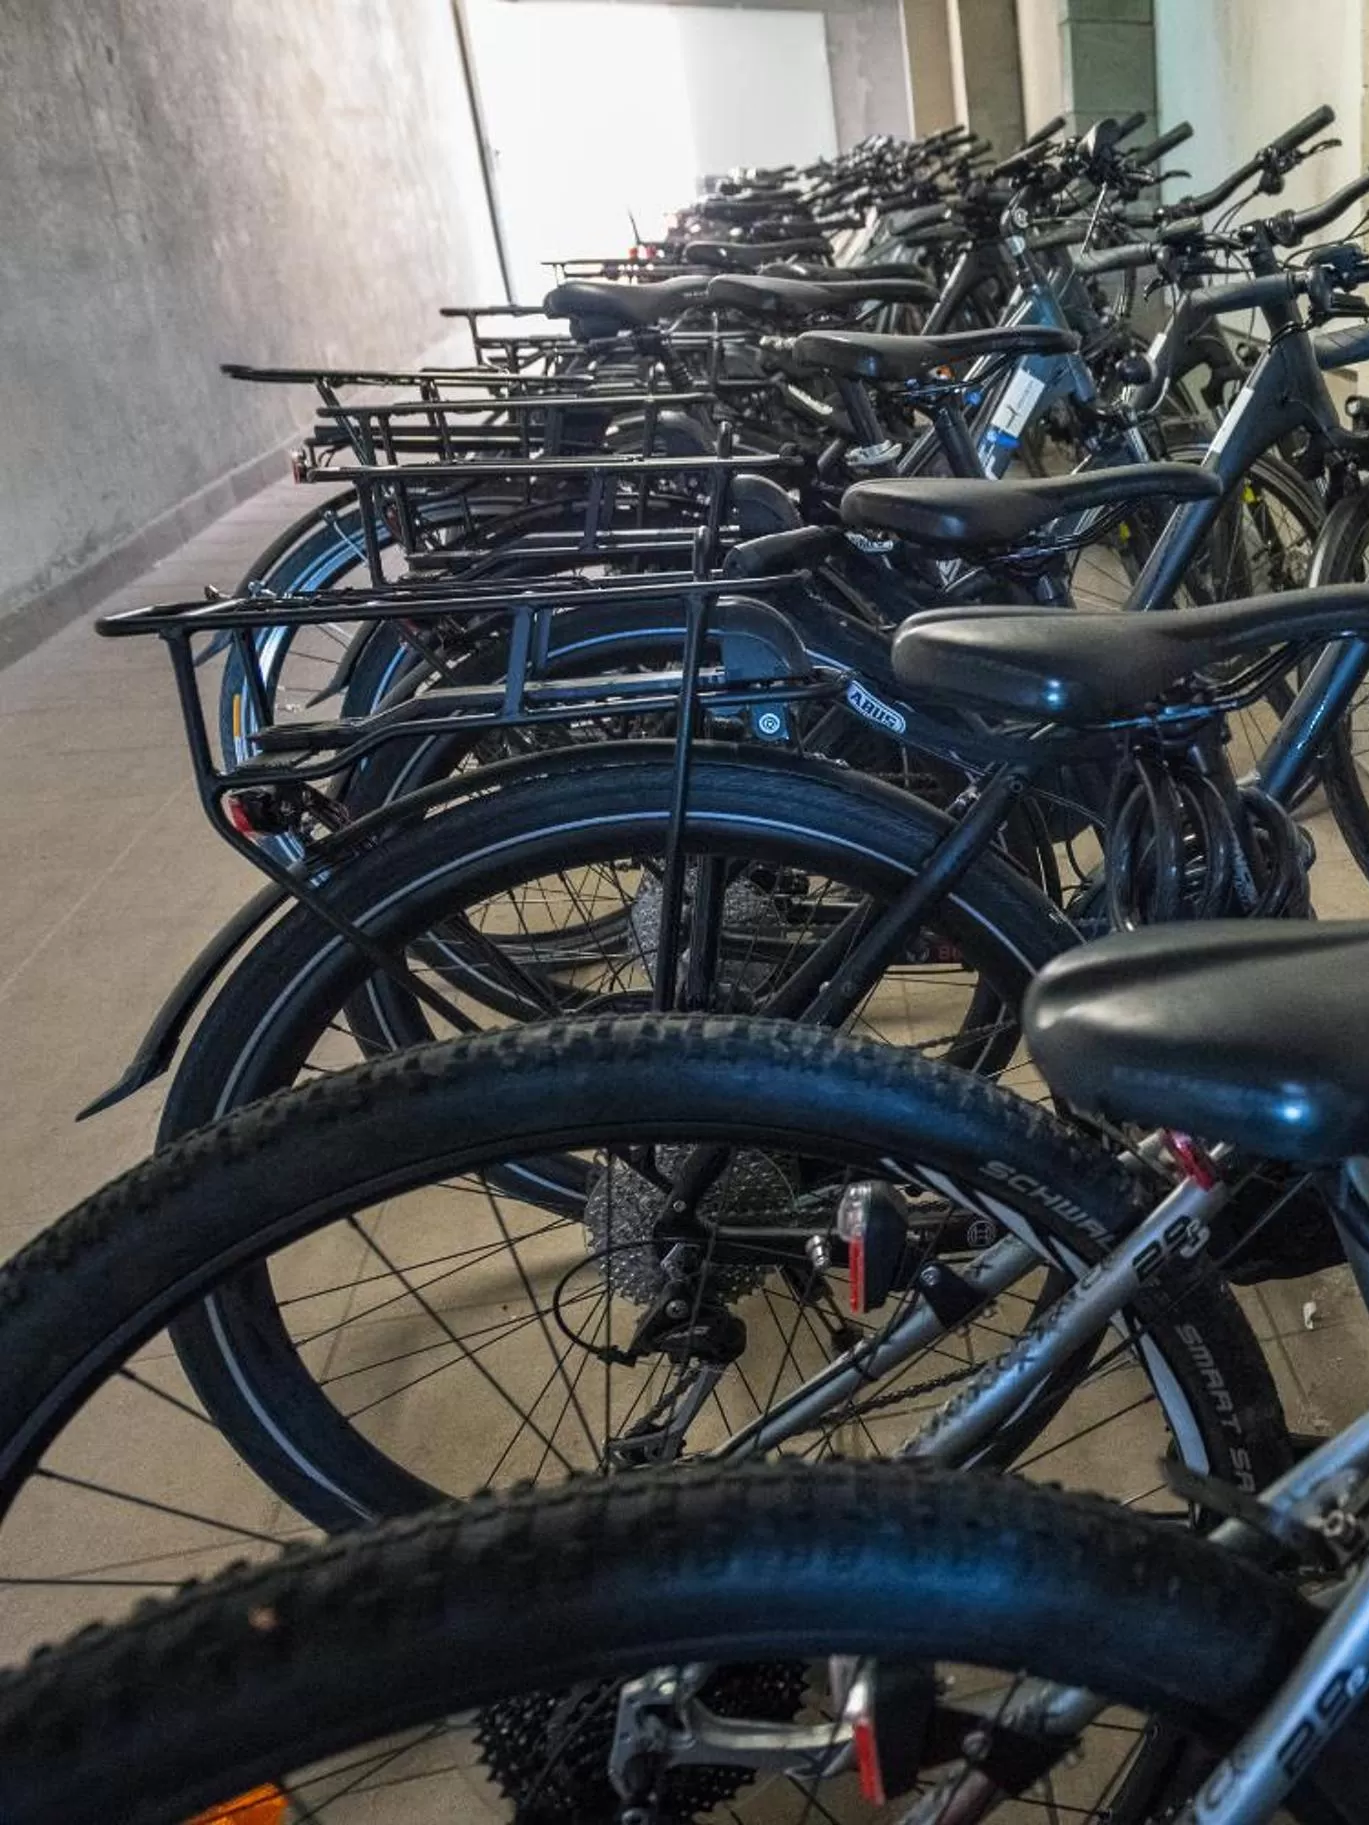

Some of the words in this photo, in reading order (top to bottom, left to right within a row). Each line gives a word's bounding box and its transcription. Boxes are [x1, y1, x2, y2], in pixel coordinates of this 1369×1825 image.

[849, 689, 900, 729] ABUS
[978, 1160, 1115, 1253] SCHWAL
[1175, 1324, 1242, 1435] SMART
[1229, 1447, 1257, 1493] SA
